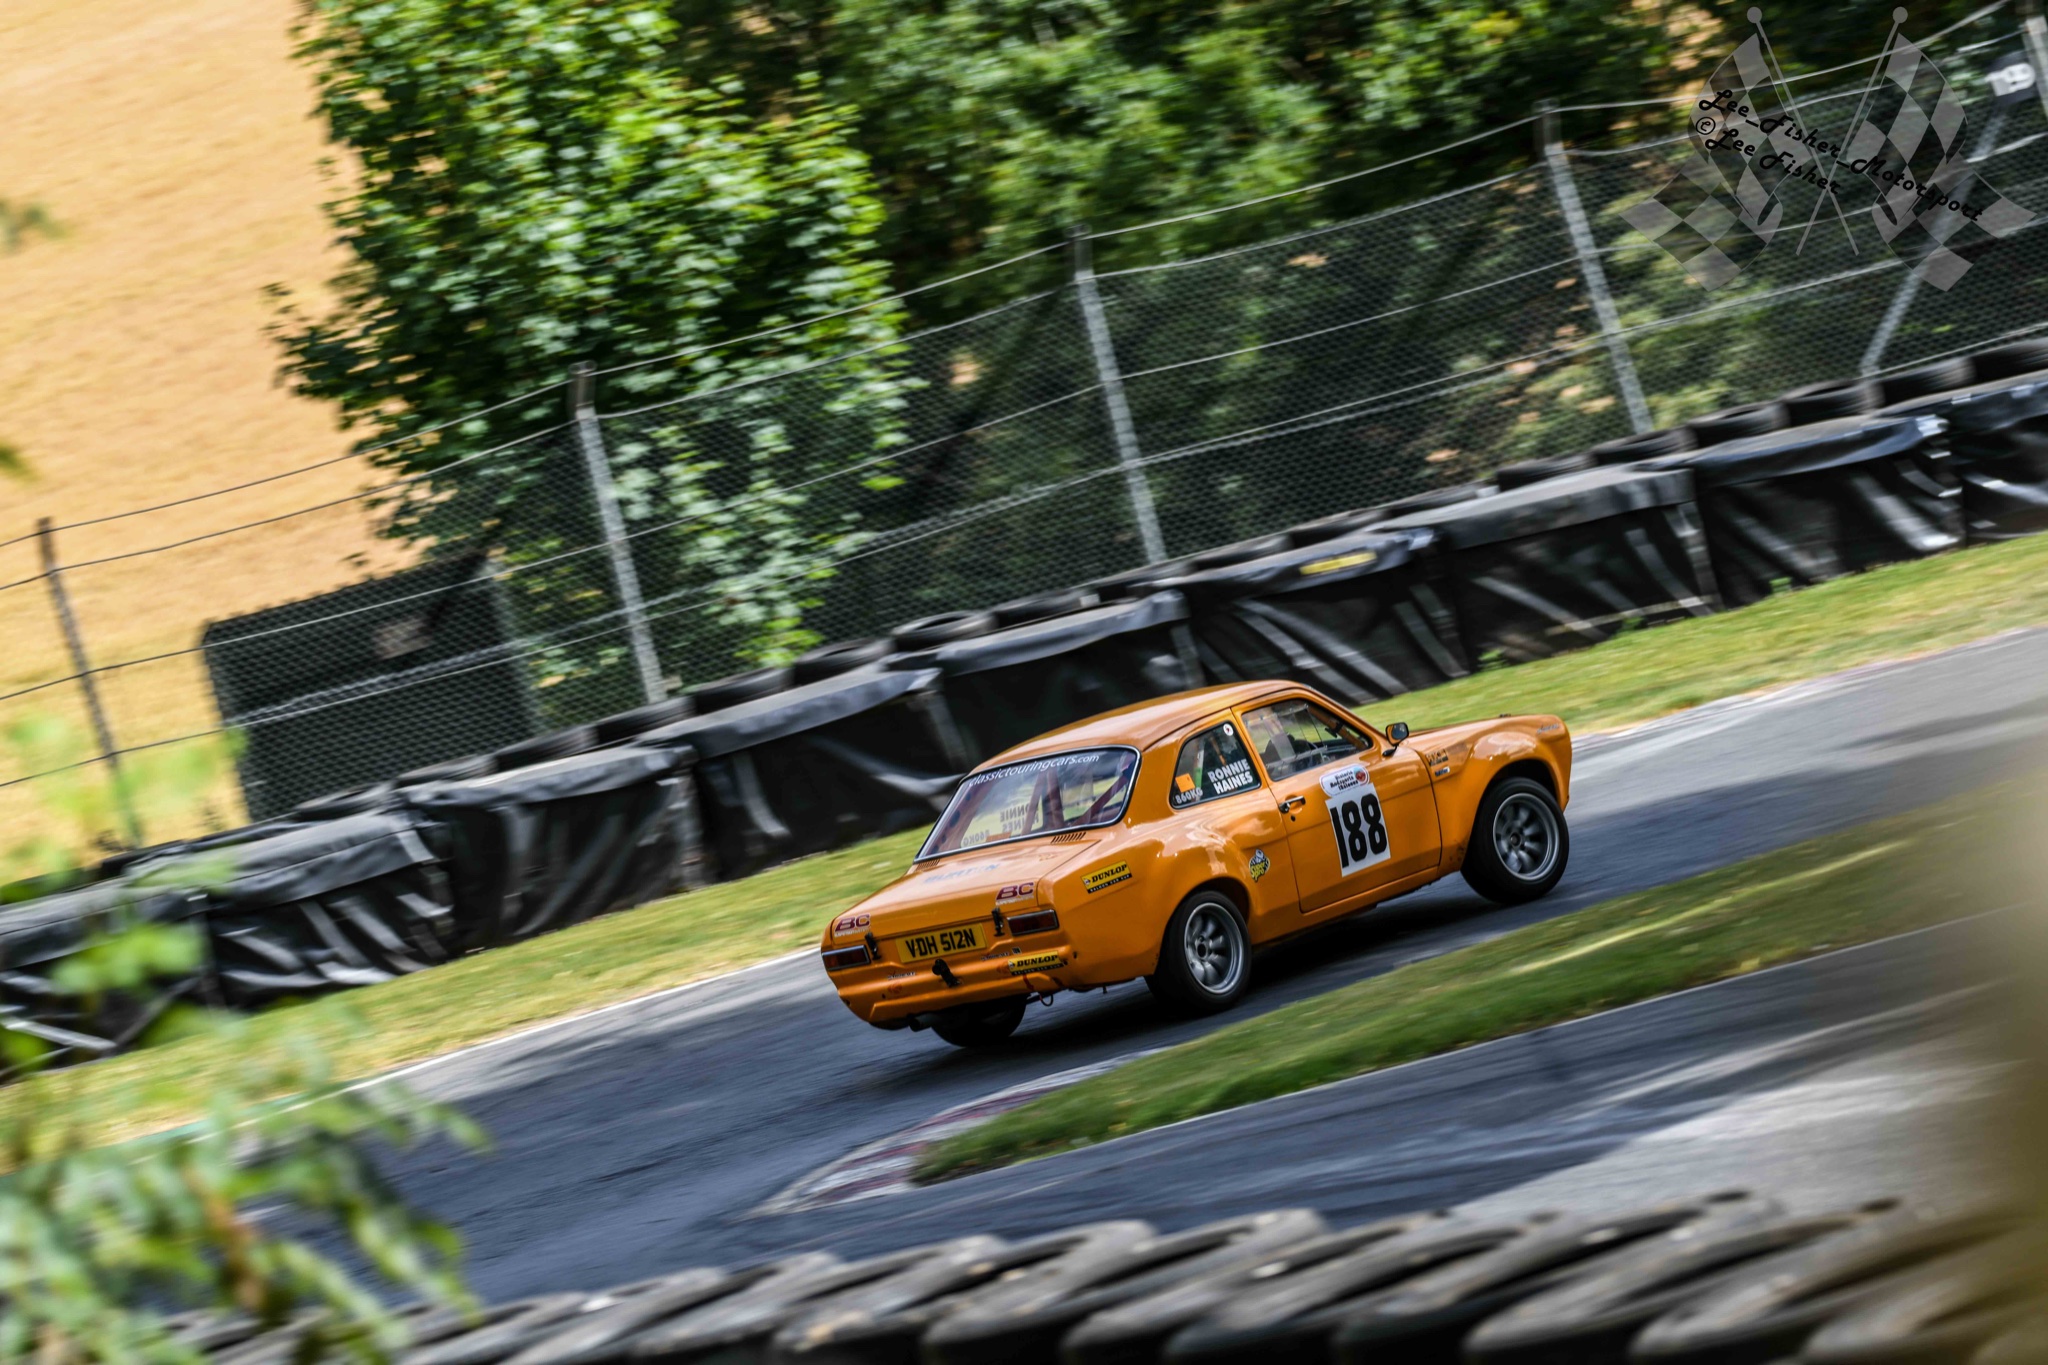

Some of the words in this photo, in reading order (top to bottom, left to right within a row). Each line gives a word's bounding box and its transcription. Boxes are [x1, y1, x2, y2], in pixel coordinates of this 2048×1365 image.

[968, 754, 1100, 787] classictouringcars.com
[1207, 758, 1251, 783] RONNIE
[1213, 771, 1254, 795] HAINES
[1330, 793, 1388, 869] 188
[1091, 864, 1127, 882] DUNLOP
[996, 882, 1034, 900] BC
[835, 914, 870, 932] BC
[905, 935, 938, 958] VDH
[940, 928, 976, 952] 512N
[1016, 955, 1058, 967] DUNLOP
